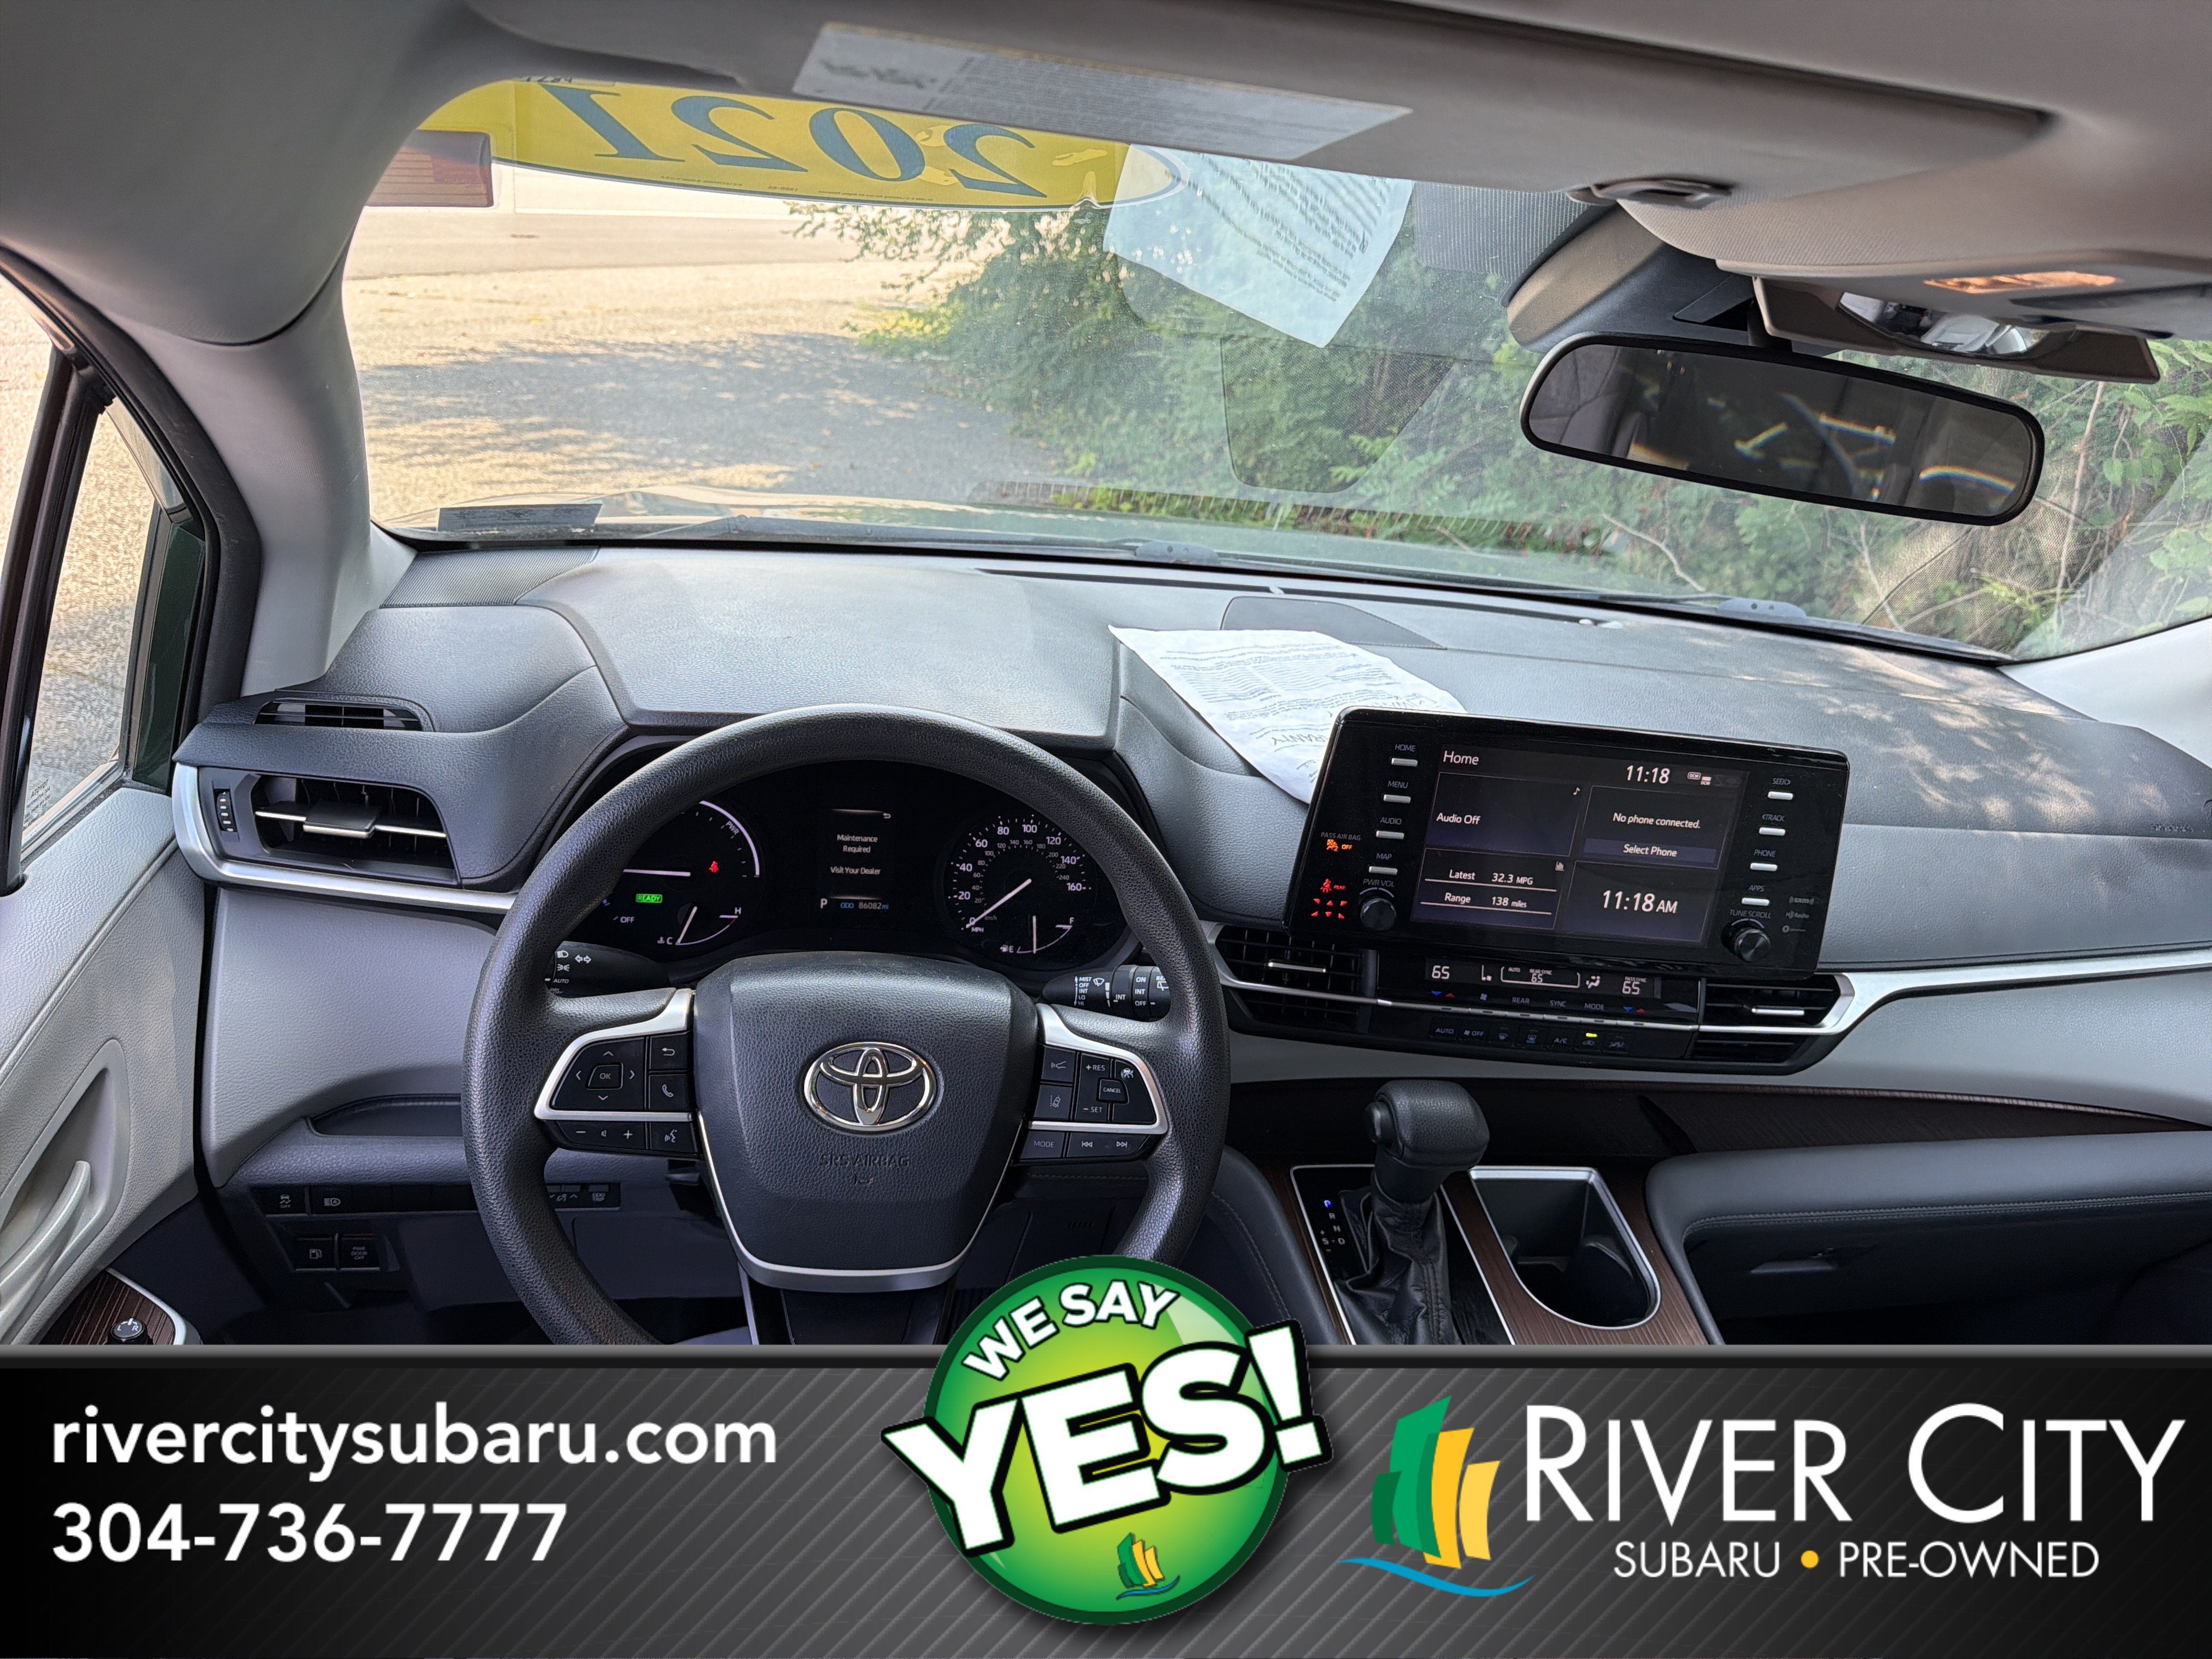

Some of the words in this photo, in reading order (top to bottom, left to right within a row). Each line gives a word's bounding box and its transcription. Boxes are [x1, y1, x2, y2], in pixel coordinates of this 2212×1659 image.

[1395, 743, 1415, 752] HOME
[1443, 751, 1479, 765] Home
[1627, 765, 1670, 784] 11:18
[1387, 780, 1409, 789] MENU
[1380, 816, 1402, 825] AUDIO
[1436, 812, 1462, 823] Audio
[1464, 815, 1481, 825] Off
[1613, 812, 1626, 822] No
[1627, 814, 1654, 825] phone
[1655, 819, 1701, 829] connected.
[725, 820, 740, 836] PWR
[997, 826, 1009, 835] 80
[1022, 824, 1037, 833] 100
[837, 834, 878, 843] Maintenance
[1046, 836, 1061, 845] 120
[975, 839, 988, 848] 60
[843, 845, 871, 854] Required
[1623, 844, 1649, 855] Select
[1651, 846, 1678, 857] Phone
[1753, 849, 1776, 857] PHONE
[1060, 856, 1076, 865] 140
[960, 863, 973, 872] 40
[1449, 869, 1476, 881] Latest
[1491, 872, 1514, 883] 32.3
[1516, 877, 1533, 885] MPG
[1066, 882, 1082, 891] 160
[1381, 879, 1395, 888] VOL
[958, 891, 970, 900] 20
[820, 898, 828, 909] P
[1444, 892, 1471, 905] Range
[1492, 896, 1509, 906] 138
[1511, 900, 1527, 909] miles
[1602, 890, 1655, 912] 11:18
[1656, 900, 1678, 913] AM
[1748, 911, 1771, 919] SCROLL
[667, 936, 673, 945] C
[1431, 965, 1450, 980] 65
[1531, 973, 1543, 983] 65
[1622, 981, 1640, 995] 65
[1549, 1000, 1567, 1008] SYNC
